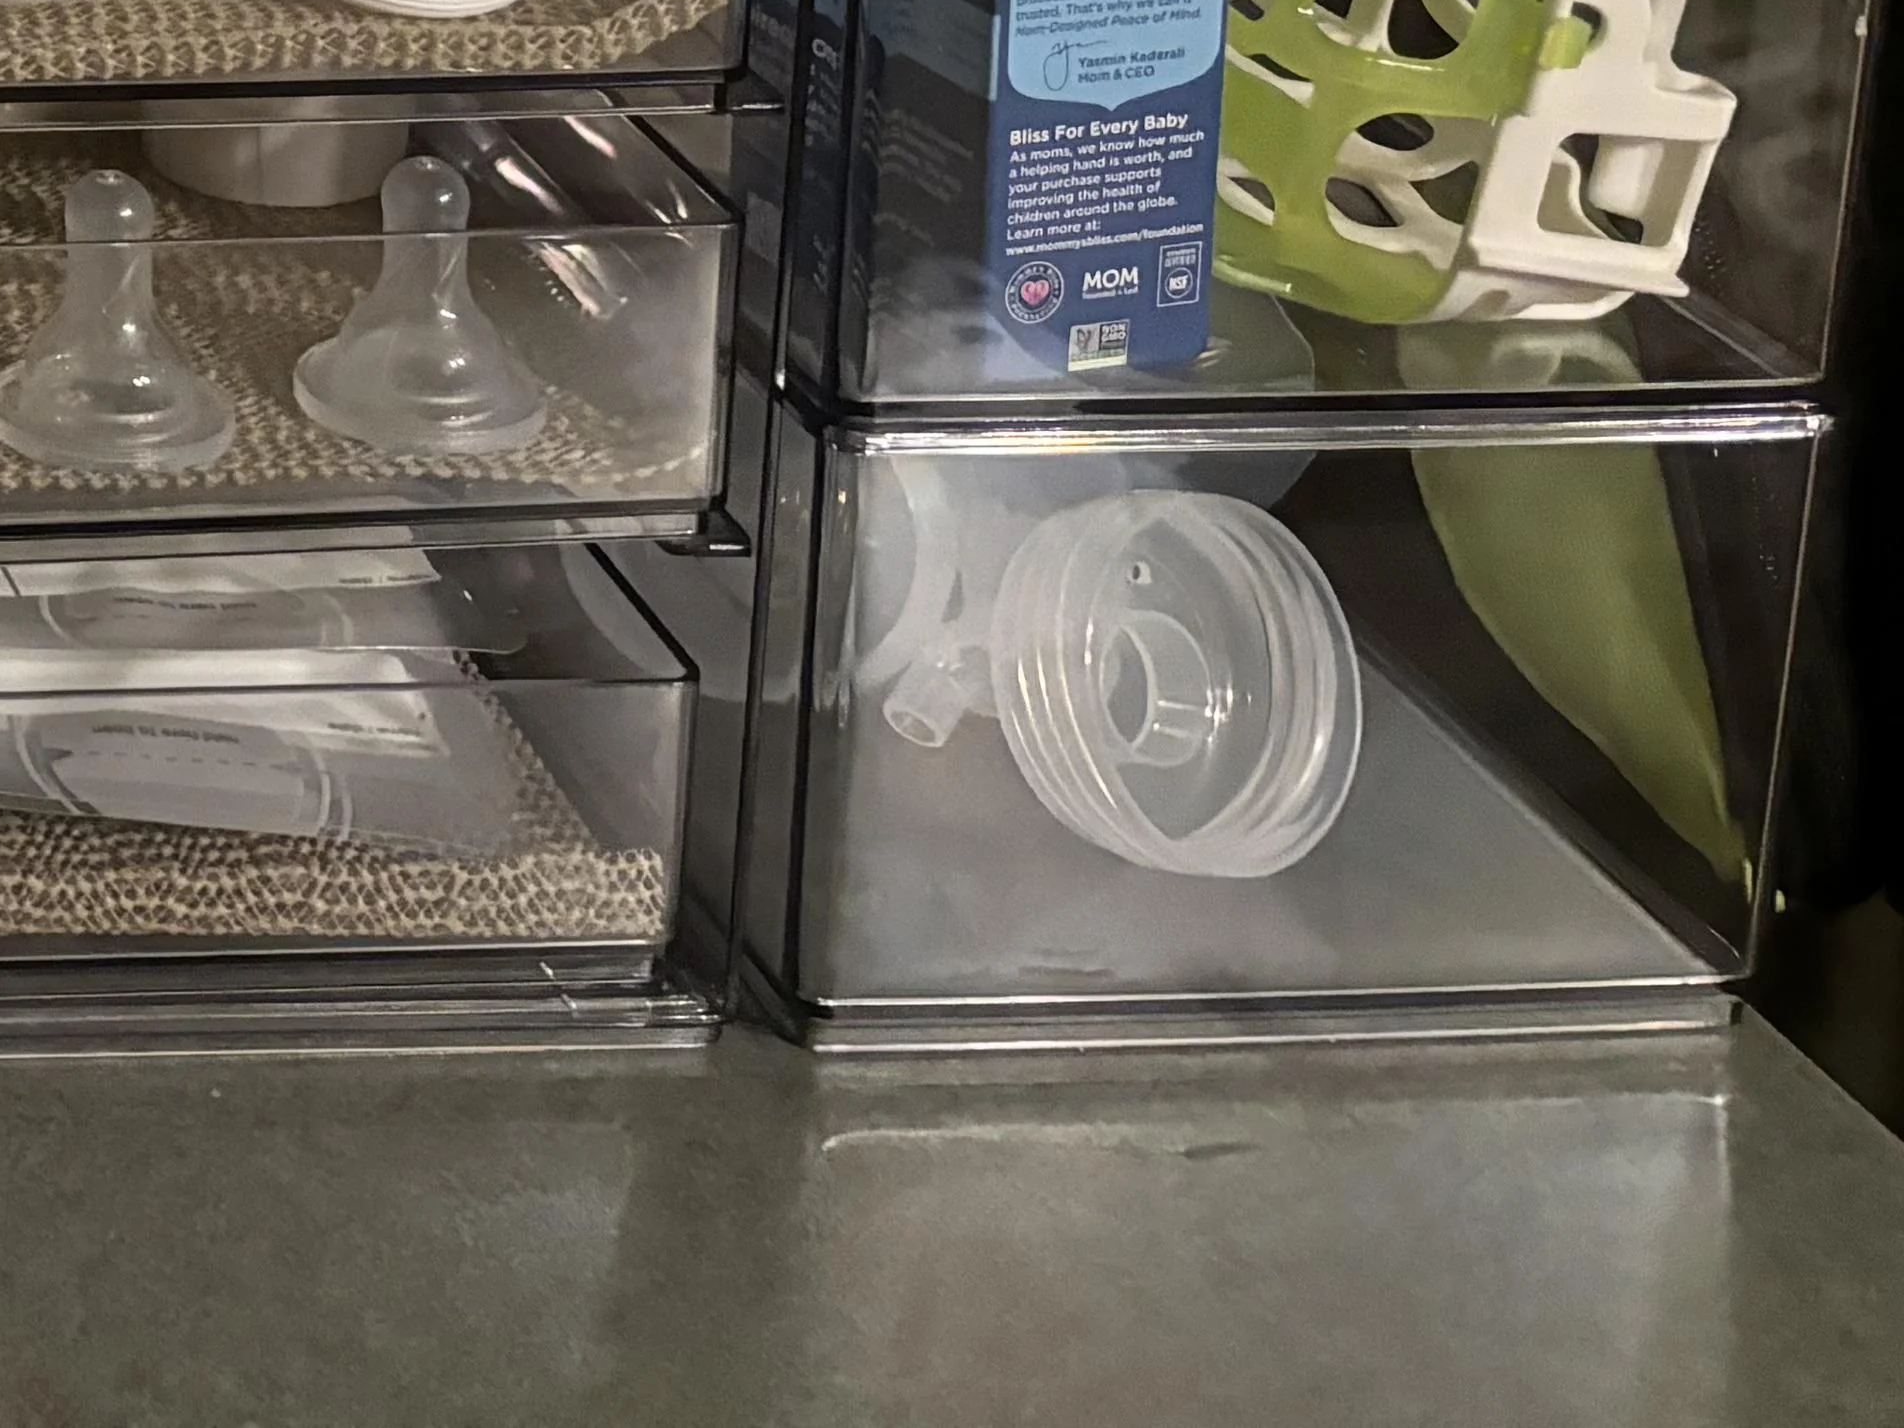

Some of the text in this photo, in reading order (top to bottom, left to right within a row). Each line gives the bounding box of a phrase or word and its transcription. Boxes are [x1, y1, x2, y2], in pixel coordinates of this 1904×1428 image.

[1066, 2, 1104, 16] That's
[1107, 0, 1132, 12] why
[1136, 0, 1155, 8] we
[1111, 14, 1149, 27] Peace
[1153, 11, 1167, 23] of
[1078, 47, 1185, 69] Yasmin Kaderali
[1078, 65, 1155, 83] Mom & CEO
[1009, 112, 1189, 145] Bliss For Every Baby
[1009, 130, 1205, 163] As moms, we know how much
[1009, 147, 1193, 178] a helping hand is worth, and
[1008, 180, 1161, 210] improving the health of
[1009, 167, 1162, 196] your purchase supports
[1007, 195, 1178, 225] children around the globe.
[1006, 221, 1101, 241] Learn more at:
[1082, 266, 1139, 291] MOM
